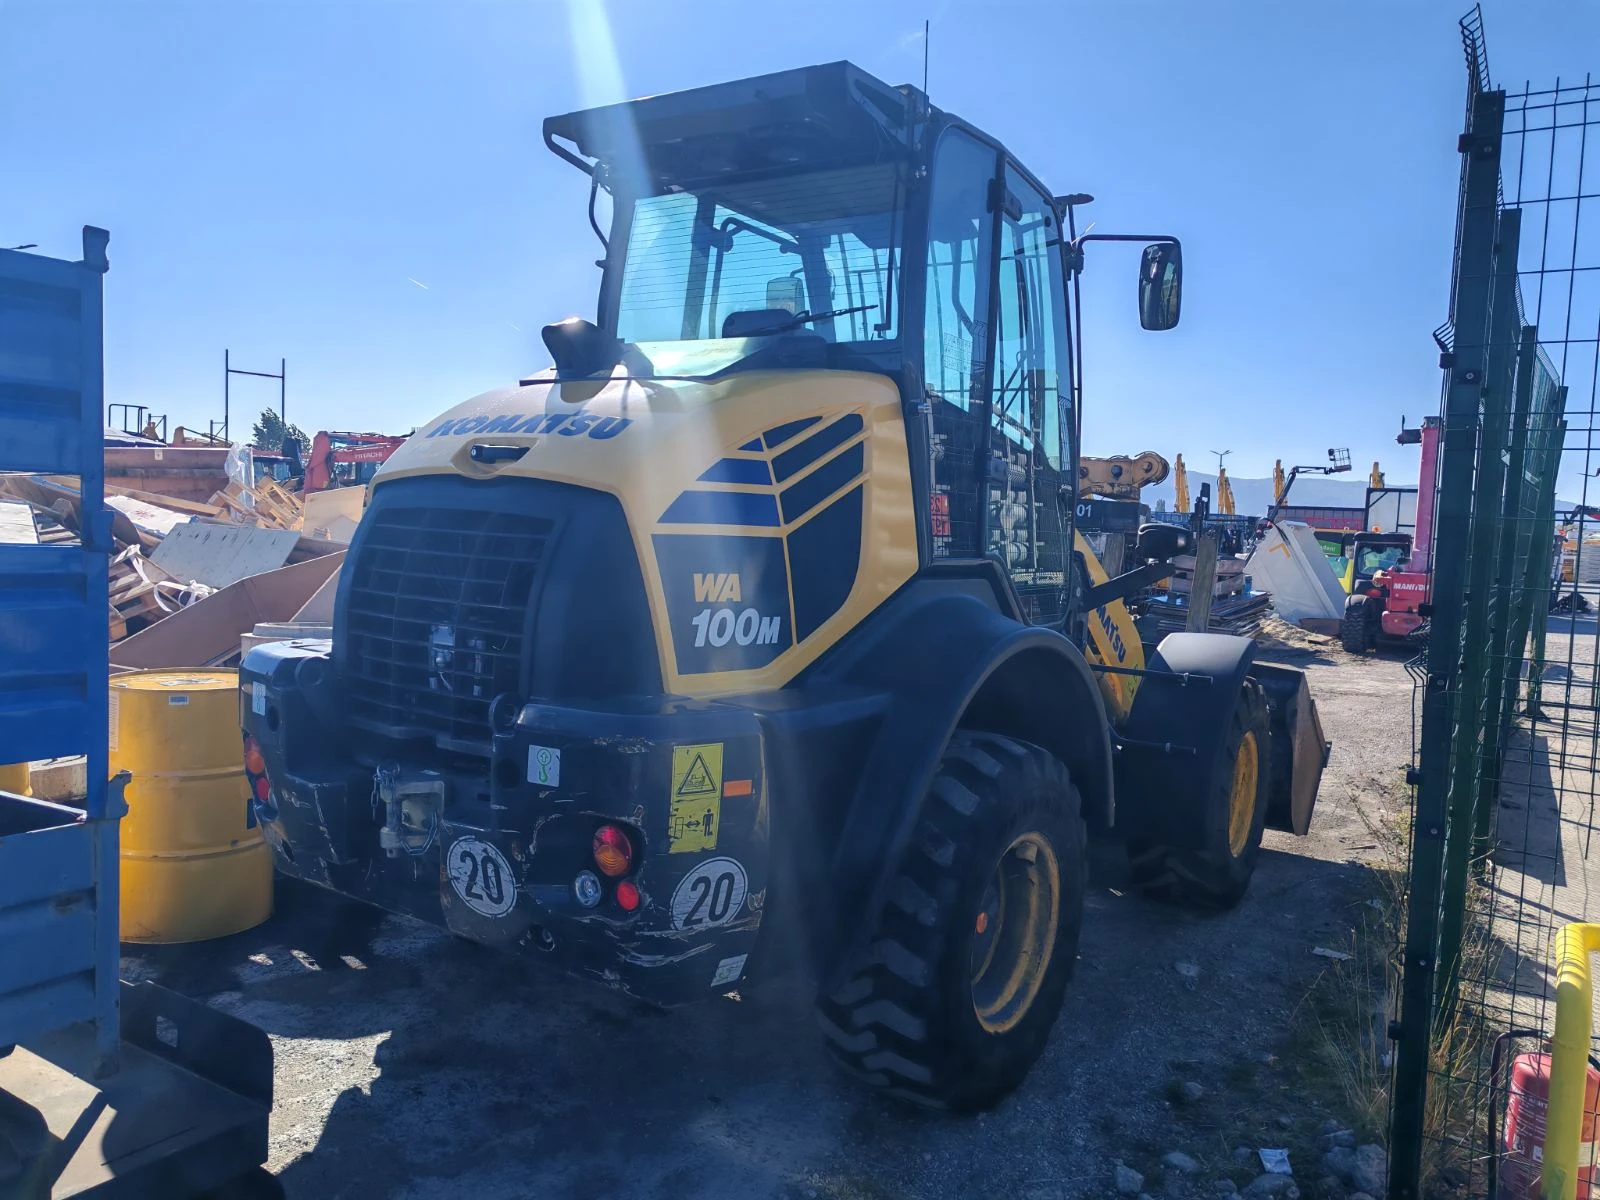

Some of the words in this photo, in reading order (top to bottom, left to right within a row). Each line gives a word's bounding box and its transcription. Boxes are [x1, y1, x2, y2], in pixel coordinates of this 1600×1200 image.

[425, 412, 634, 440] KOMATSU
[354, 451, 383, 459] HITACHI
[693, 572, 742, 603] WA
[691, 607, 781, 648] 100M
[459, 849, 505, 905] 20
[682, 872, 736, 927] 20
